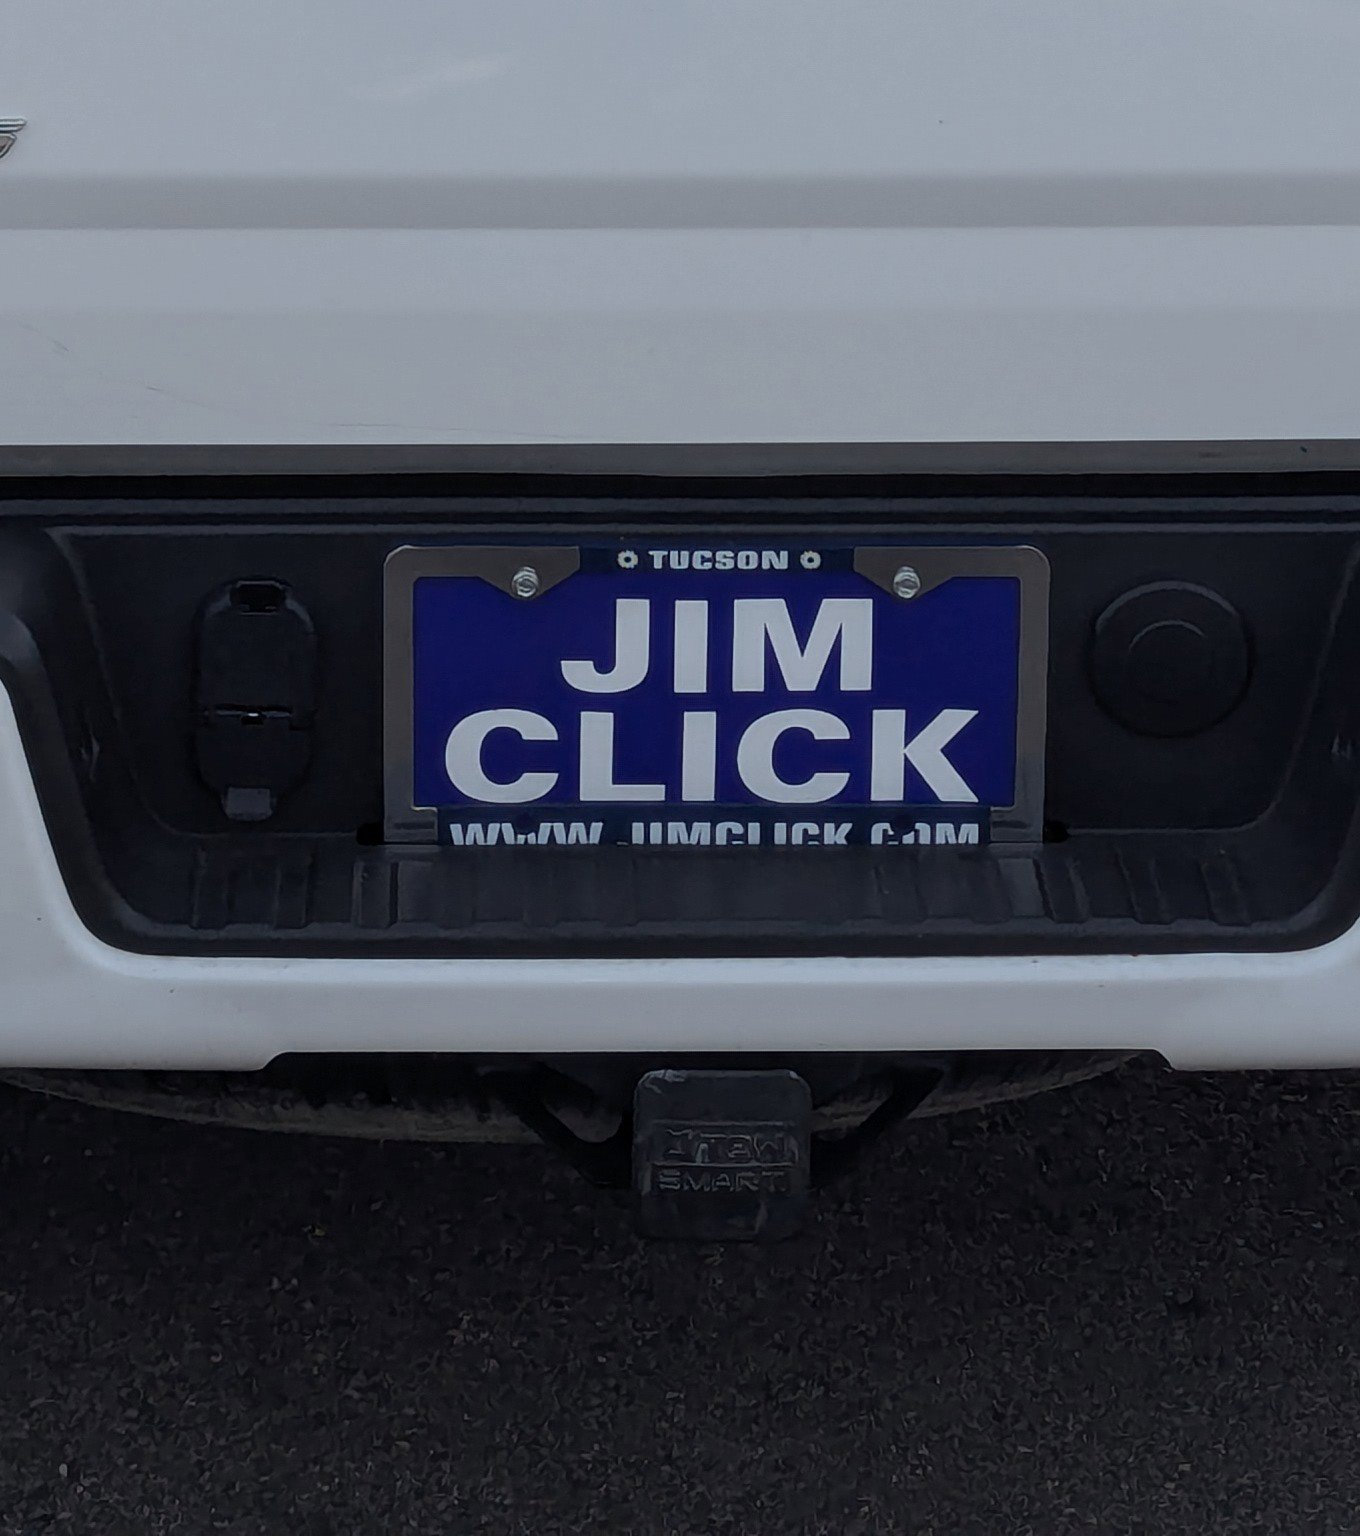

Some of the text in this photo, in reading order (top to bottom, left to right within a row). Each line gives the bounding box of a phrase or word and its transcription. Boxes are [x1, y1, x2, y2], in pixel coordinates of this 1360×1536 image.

[647, 549, 789, 570] TUCSON
[560, 597, 874, 694] JIM
[444, 707, 980, 804] CLICK
[448, 821, 980, 846] WWWJIMCLICKCOM
[658, 1168, 788, 1193] SMART
